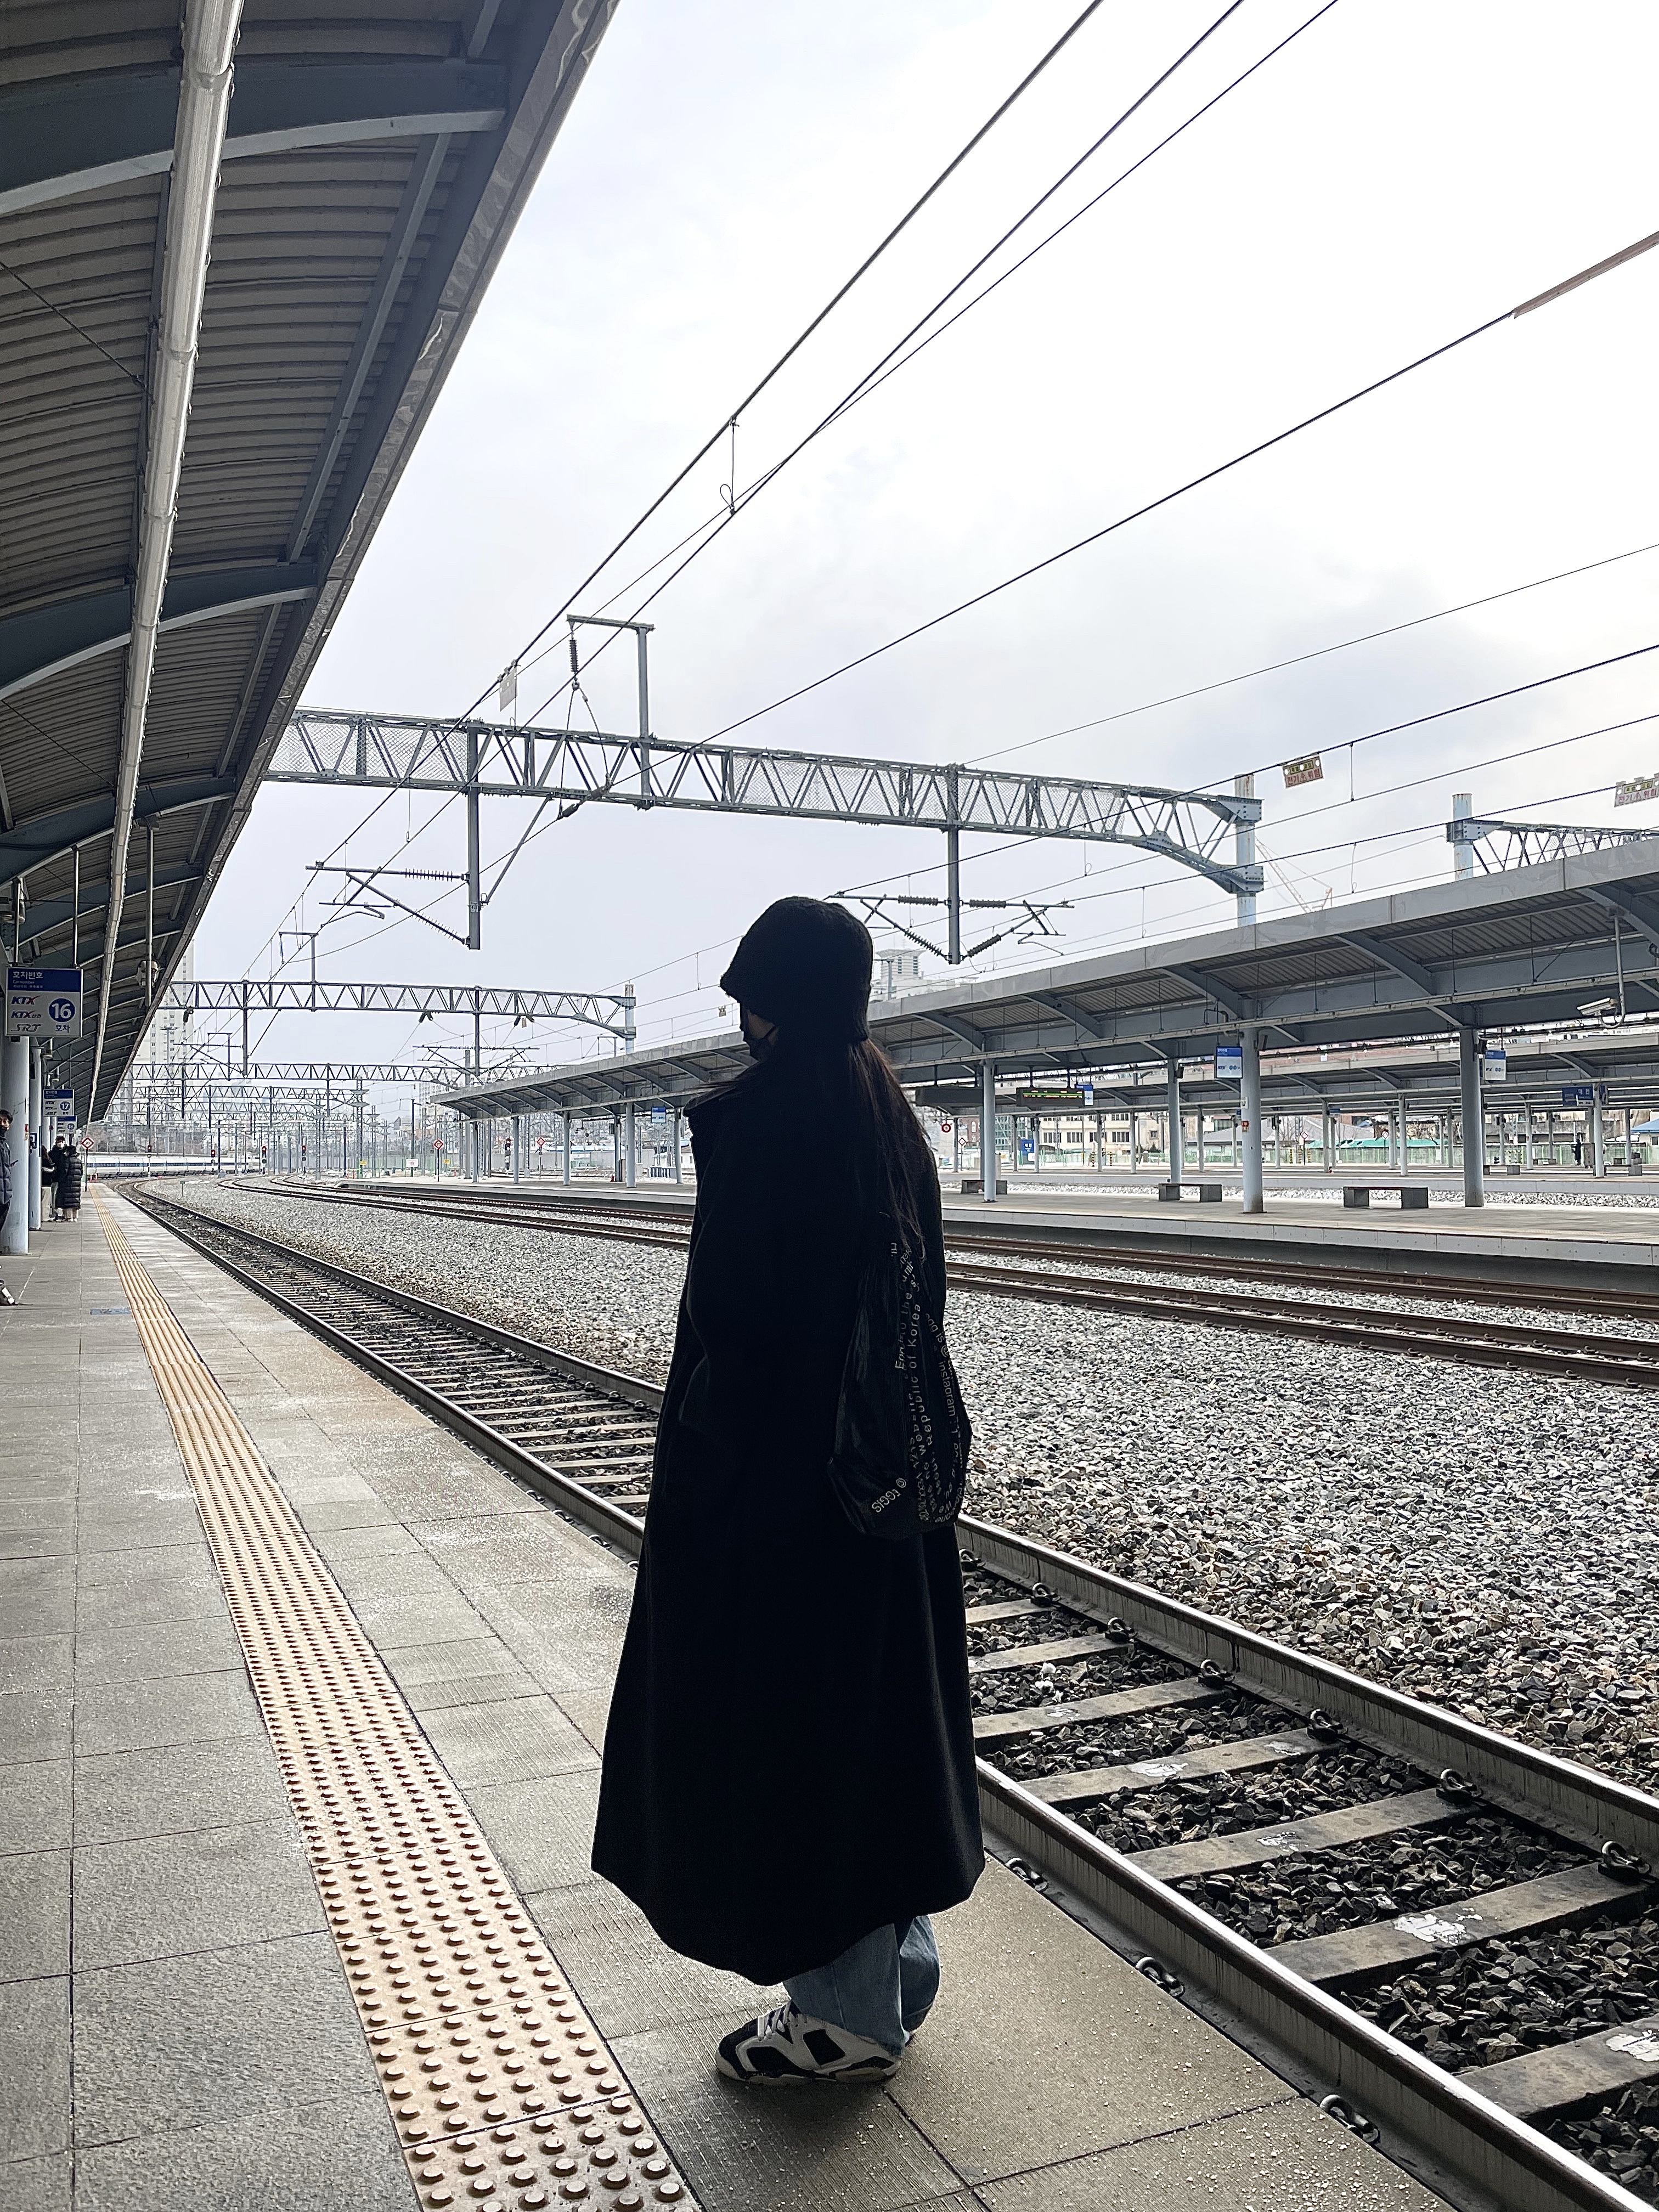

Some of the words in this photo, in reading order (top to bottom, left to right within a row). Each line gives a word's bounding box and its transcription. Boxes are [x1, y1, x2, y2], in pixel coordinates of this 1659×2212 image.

[13, 971, 43, 980] 호차번호
[11, 995, 42, 1005] KTX
[52, 1003, 71, 1019] 16
[10, 1023, 42, 1032] SRT
[55, 1024, 70, 1033] 호차
[907, 1304, 921, 1347] Korea
[935, 1333, 944, 1343] is
[907, 1355, 917, 1369] of
[938, 1361, 956, 1417] instagram
[910, 1376, 933, 1446] Republic
